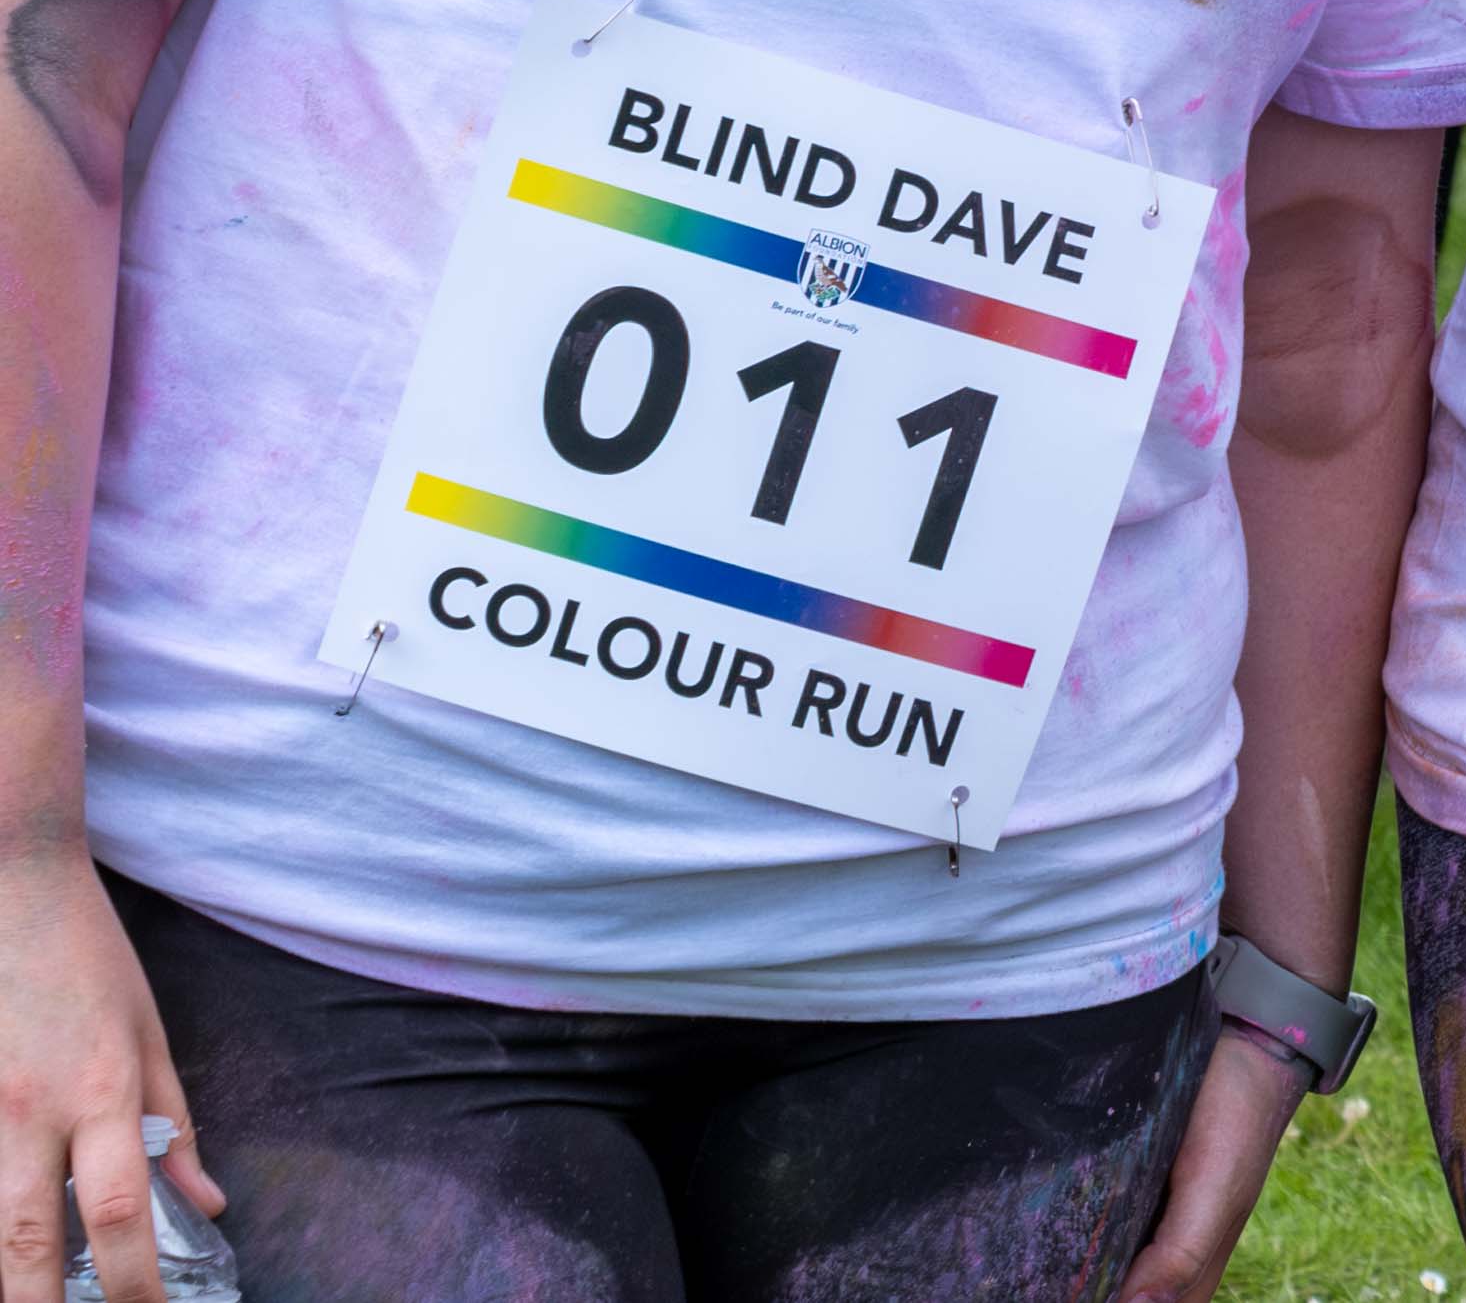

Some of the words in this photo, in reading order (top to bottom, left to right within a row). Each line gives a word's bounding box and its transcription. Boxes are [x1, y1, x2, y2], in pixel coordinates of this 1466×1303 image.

[609, 88, 856, 208] BLIND
[878, 169, 1095, 284] DAVE
[810, 233, 867, 258] ALBION
[771, 301, 783, 311] Be
[784, 306, 804, 318] part
[805, 312, 817, 320] of
[817, 316, 832, 324] our
[834, 319, 859, 334] family
[541, 286, 998, 570] 011
[430, 567, 774, 717] COLOUR
[792, 669, 964, 767] RUN
